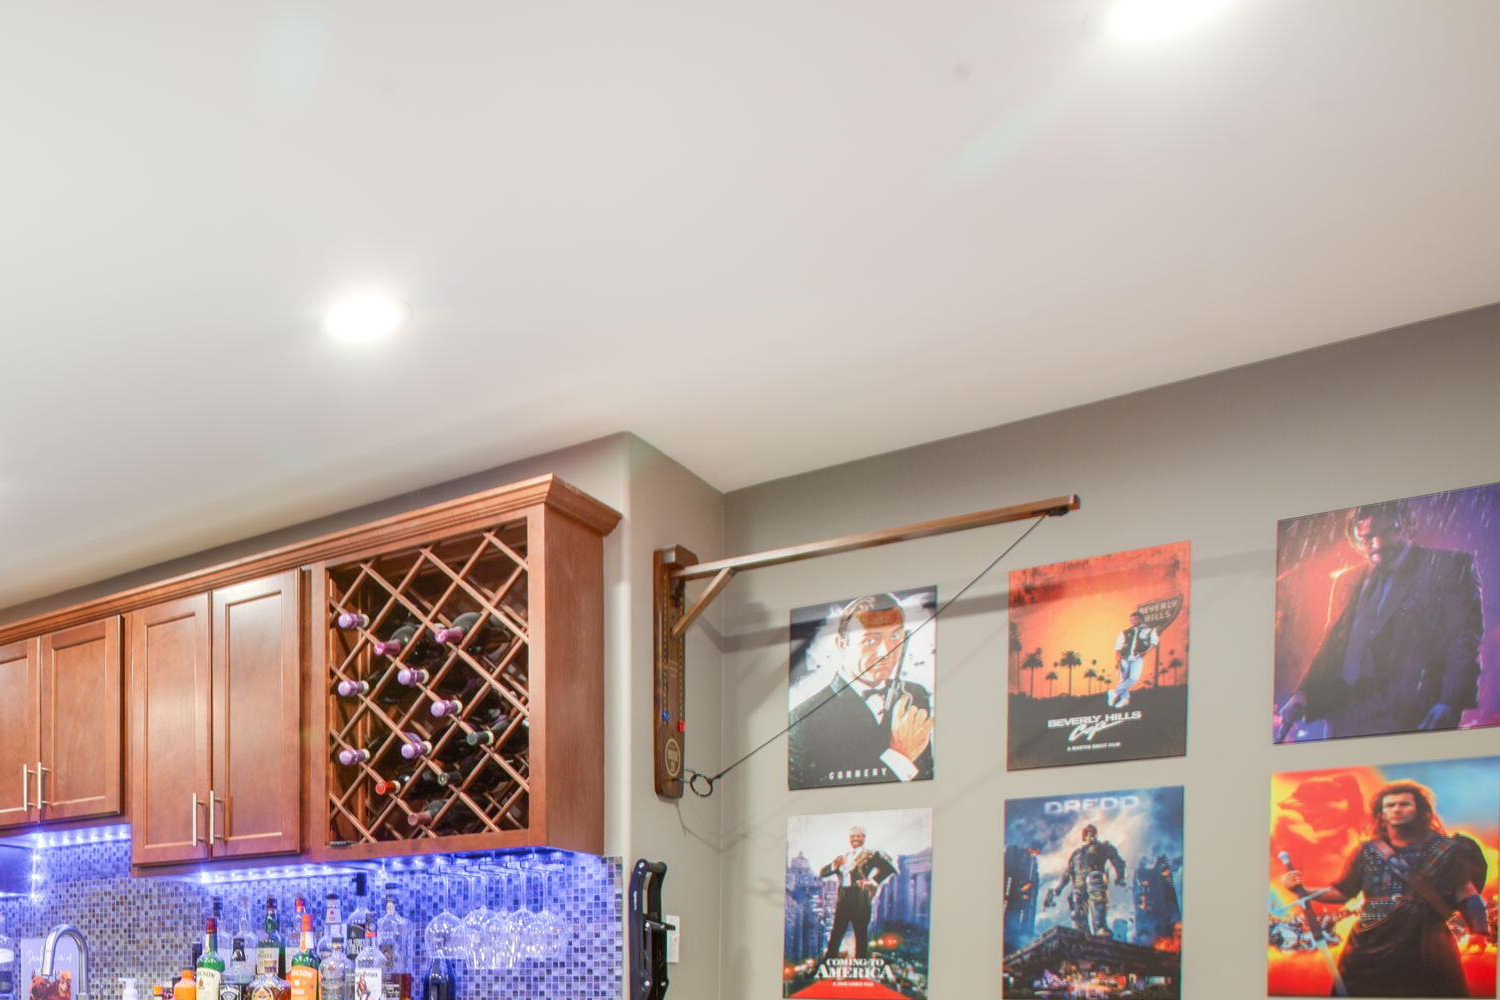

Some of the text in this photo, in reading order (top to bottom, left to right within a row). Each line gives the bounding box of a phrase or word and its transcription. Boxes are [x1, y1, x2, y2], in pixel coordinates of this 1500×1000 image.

[1047, 710, 1143, 729] BEVERLY HILLS
[1068, 720, 1125, 742] Cop
[828, 767, 888, 781] CONNERY
[1043, 795, 1140, 816] DREDD
[826, 957, 867, 967] COMING
[813, 963, 896, 982] AMERICA
